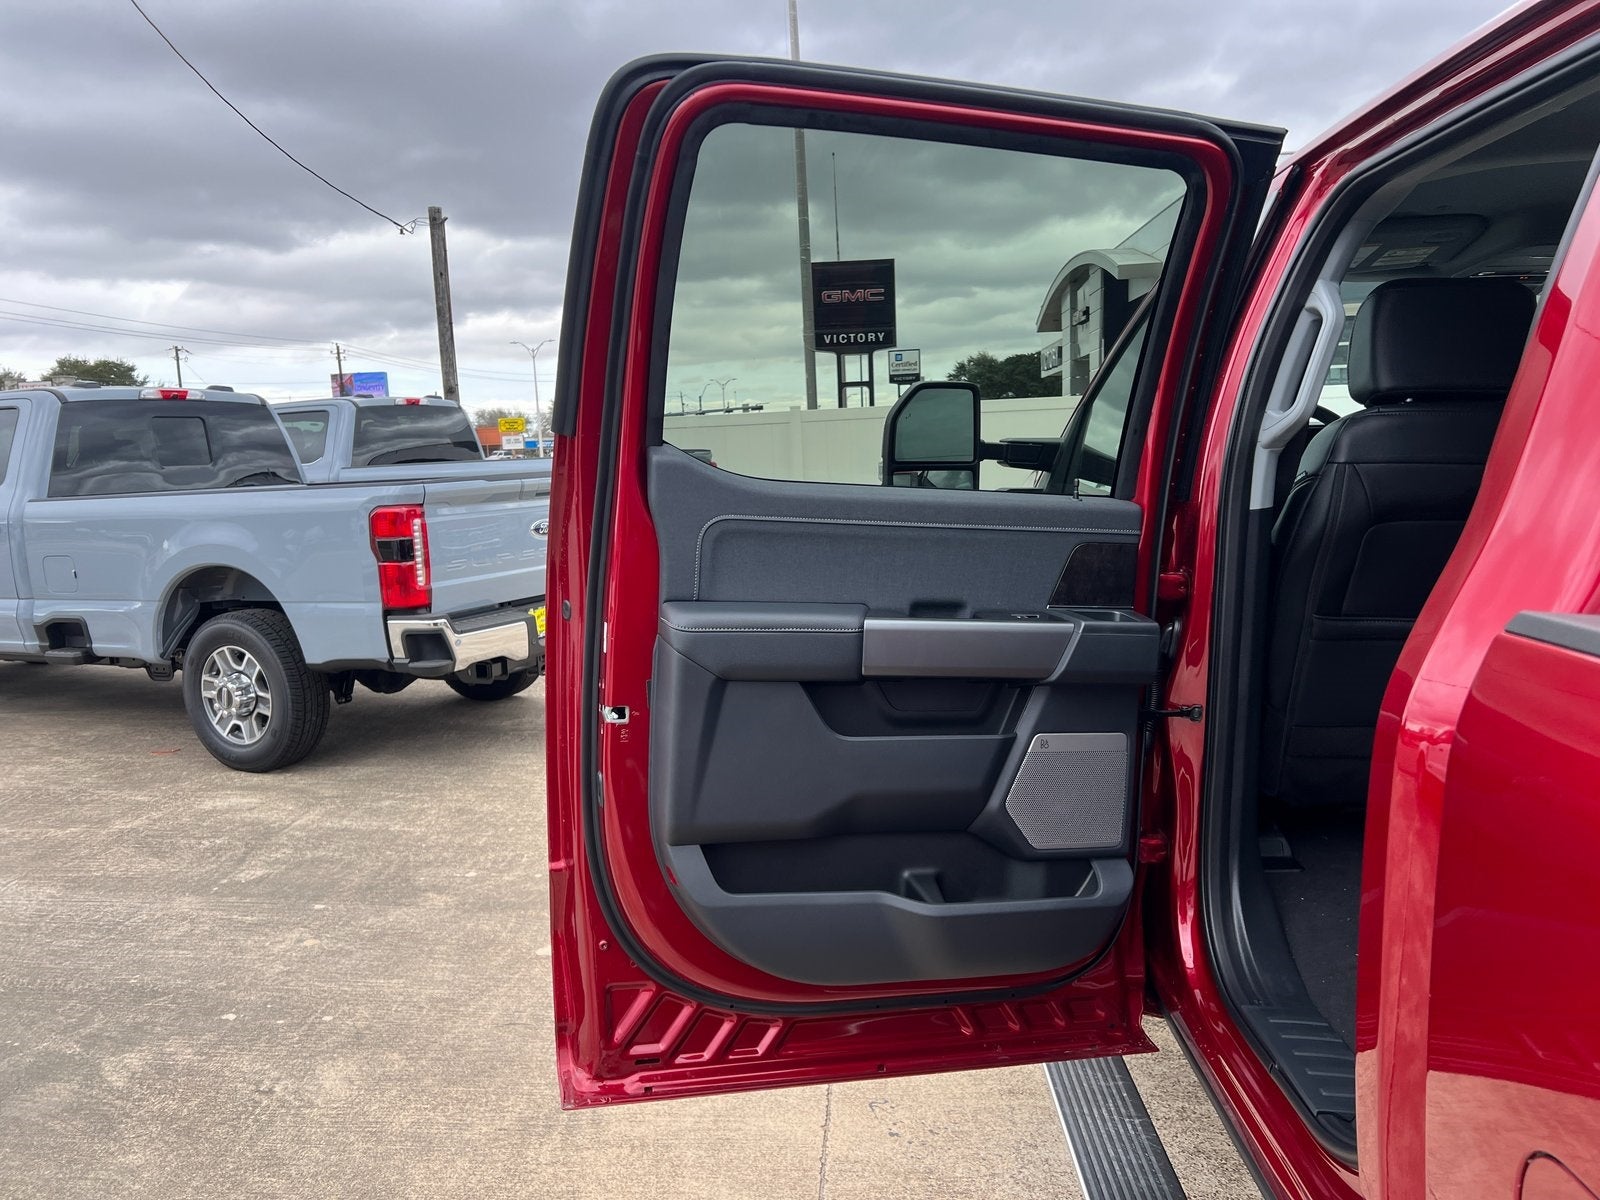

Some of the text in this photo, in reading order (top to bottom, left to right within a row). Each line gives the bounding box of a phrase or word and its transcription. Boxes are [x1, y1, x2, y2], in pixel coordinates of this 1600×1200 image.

[821, 288, 885, 304] GMC
[823, 332, 885, 344] VICTORY
[891, 360, 918, 369] Certified
